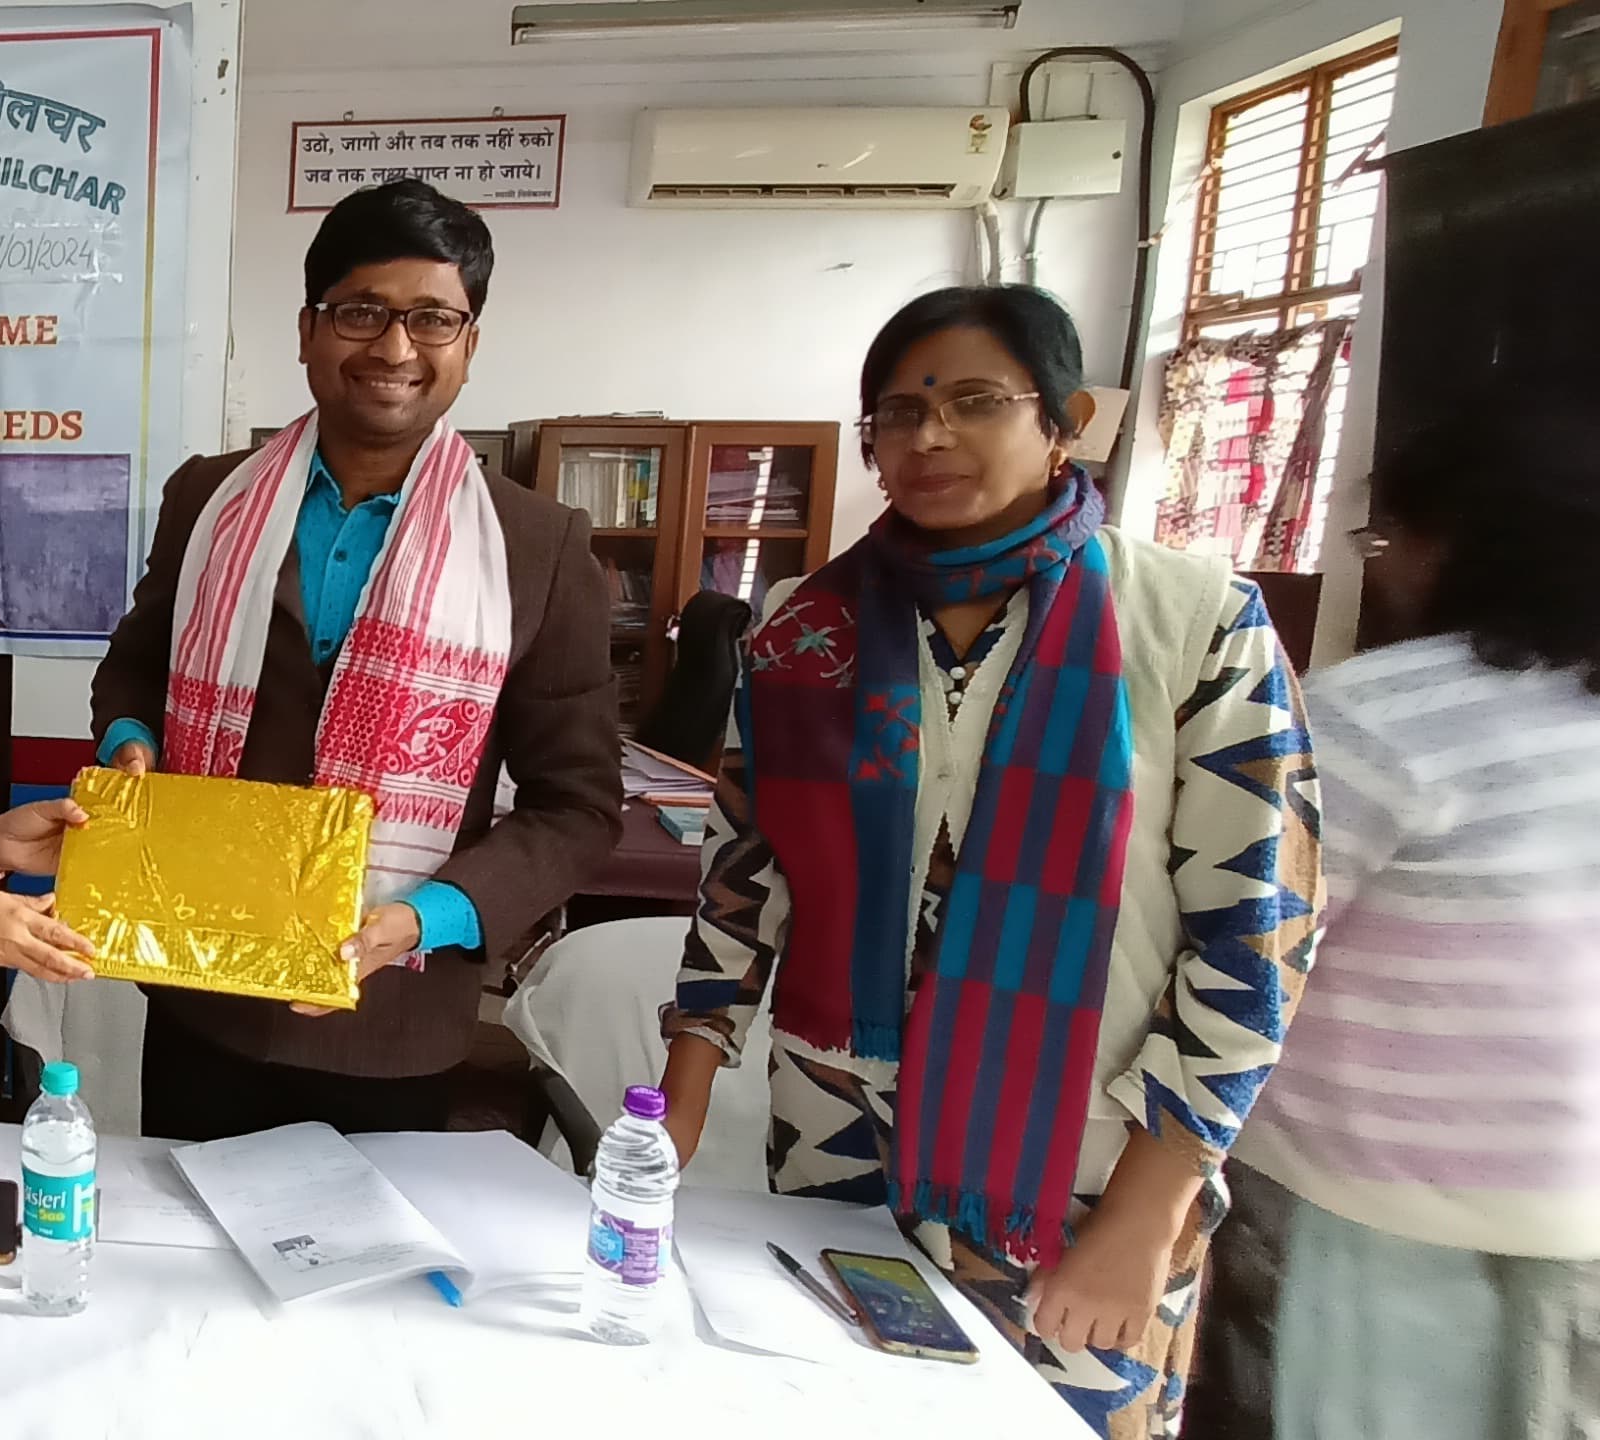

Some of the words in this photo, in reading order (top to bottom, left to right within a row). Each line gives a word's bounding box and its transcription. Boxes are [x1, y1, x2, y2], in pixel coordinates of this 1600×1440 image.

[340, 131, 381, 151] जागो
[385, 130, 416, 150] और
[420, 134, 447, 149] तब
[451, 134, 480, 149] तक
[485, 127, 514, 150] नहीं
[519, 127, 554, 148] रुको
[304, 169, 333, 183] जब
[337, 168, 366, 183] तक
[454, 166, 473, 180] ना
[478, 160, 495, 182] हो
